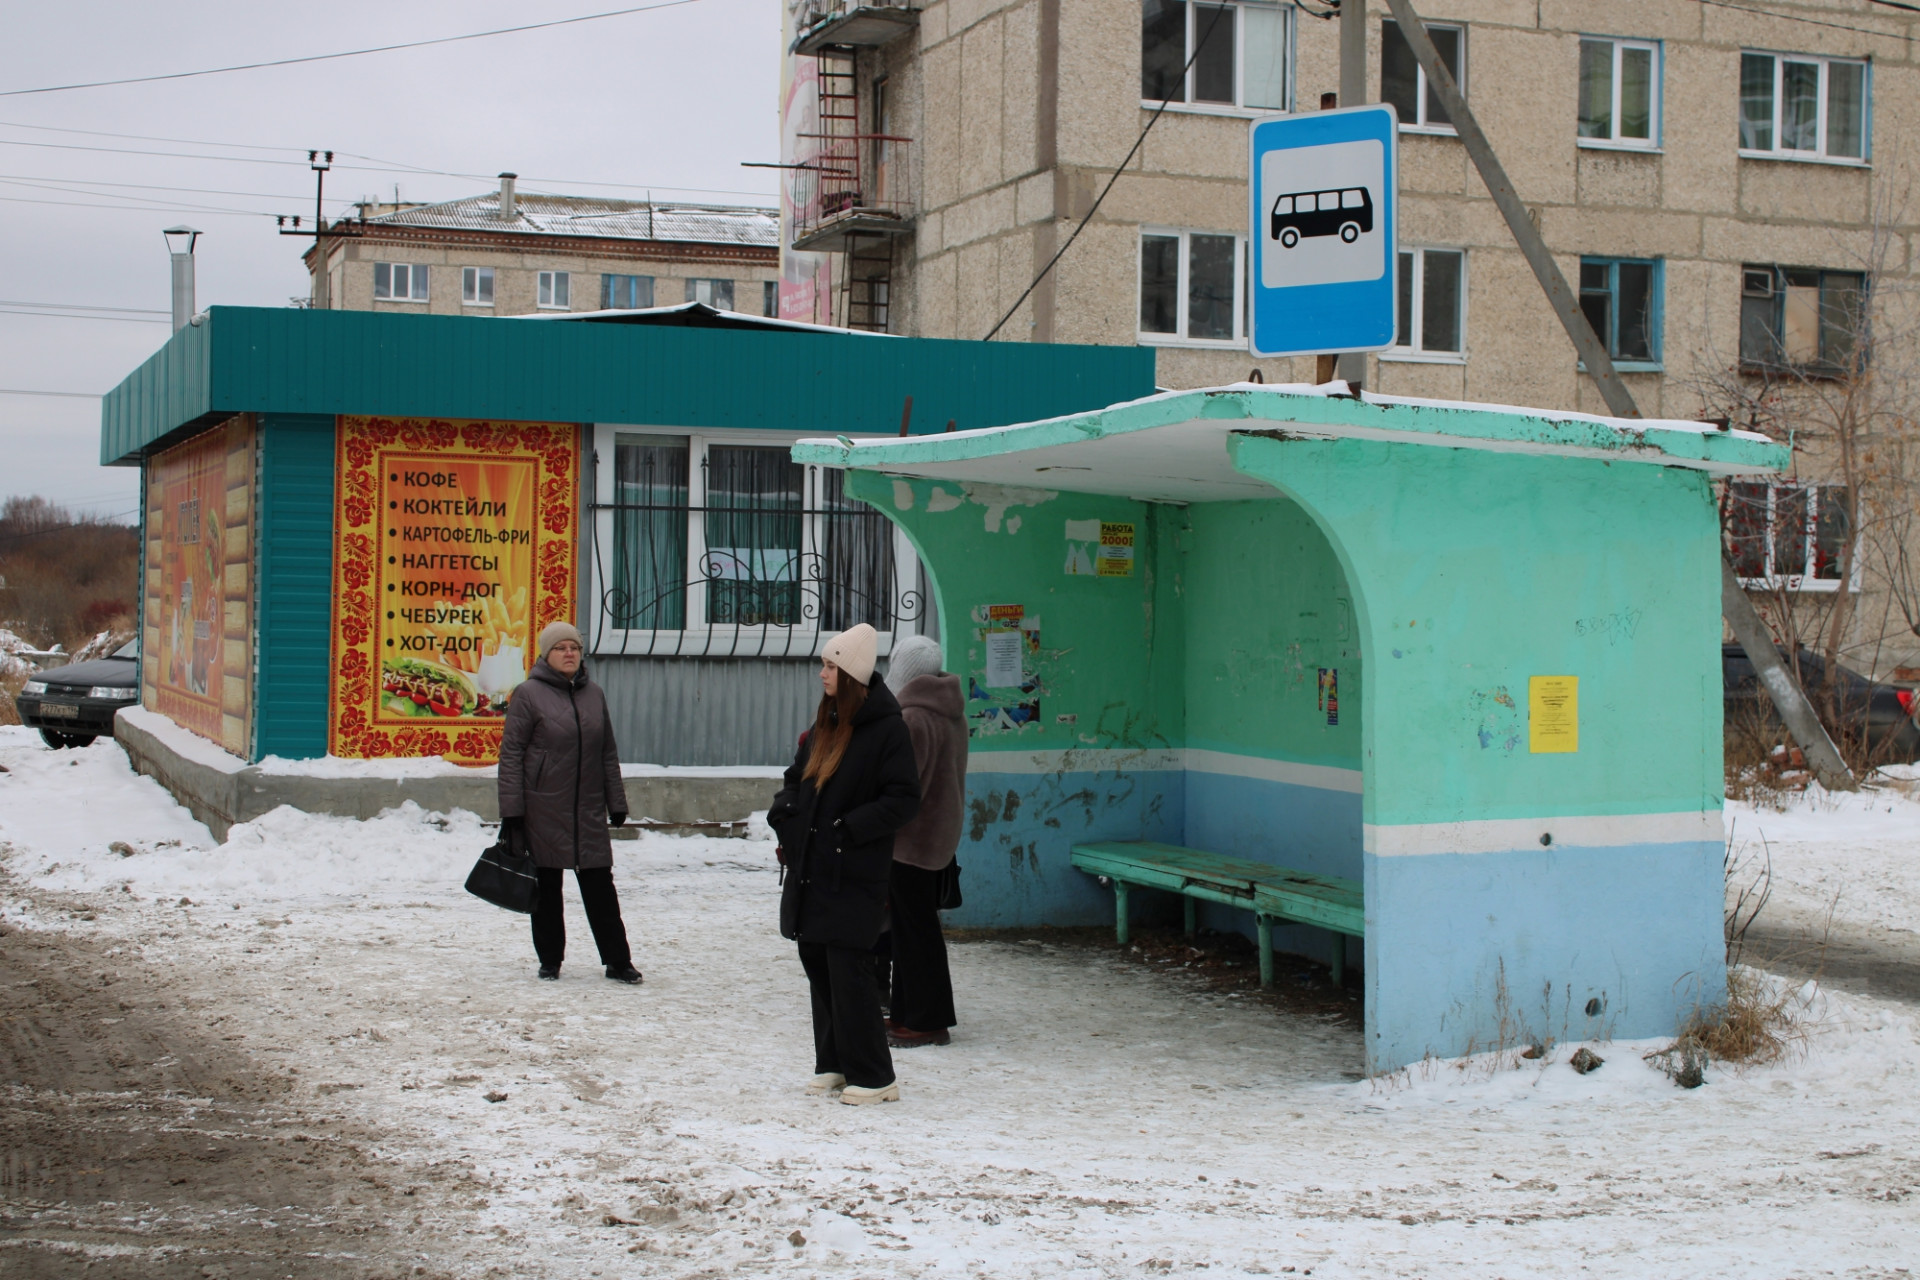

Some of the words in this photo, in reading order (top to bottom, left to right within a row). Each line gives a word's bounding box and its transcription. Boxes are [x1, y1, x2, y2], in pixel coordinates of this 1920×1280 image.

[404, 471, 457, 488] КОФЕ
[403, 496, 507, 518] КОКТЕЙЛИ
[402, 525, 530, 545] КАРТОФЕЛЬ-ФРИ
[1102, 523, 1133, 533] РАБОТА
[1102, 535, 1129, 545] 2000
[402, 553, 499, 571] НАГГЕТСЫ
[401, 580, 501, 600] КОРН-ДОГ
[400, 607, 483, 625] ЧЕБУРЕК
[991, 605, 1024, 615] ДЕНЬГИ
[399, 635, 483, 654] ХОТ-ДОГ
